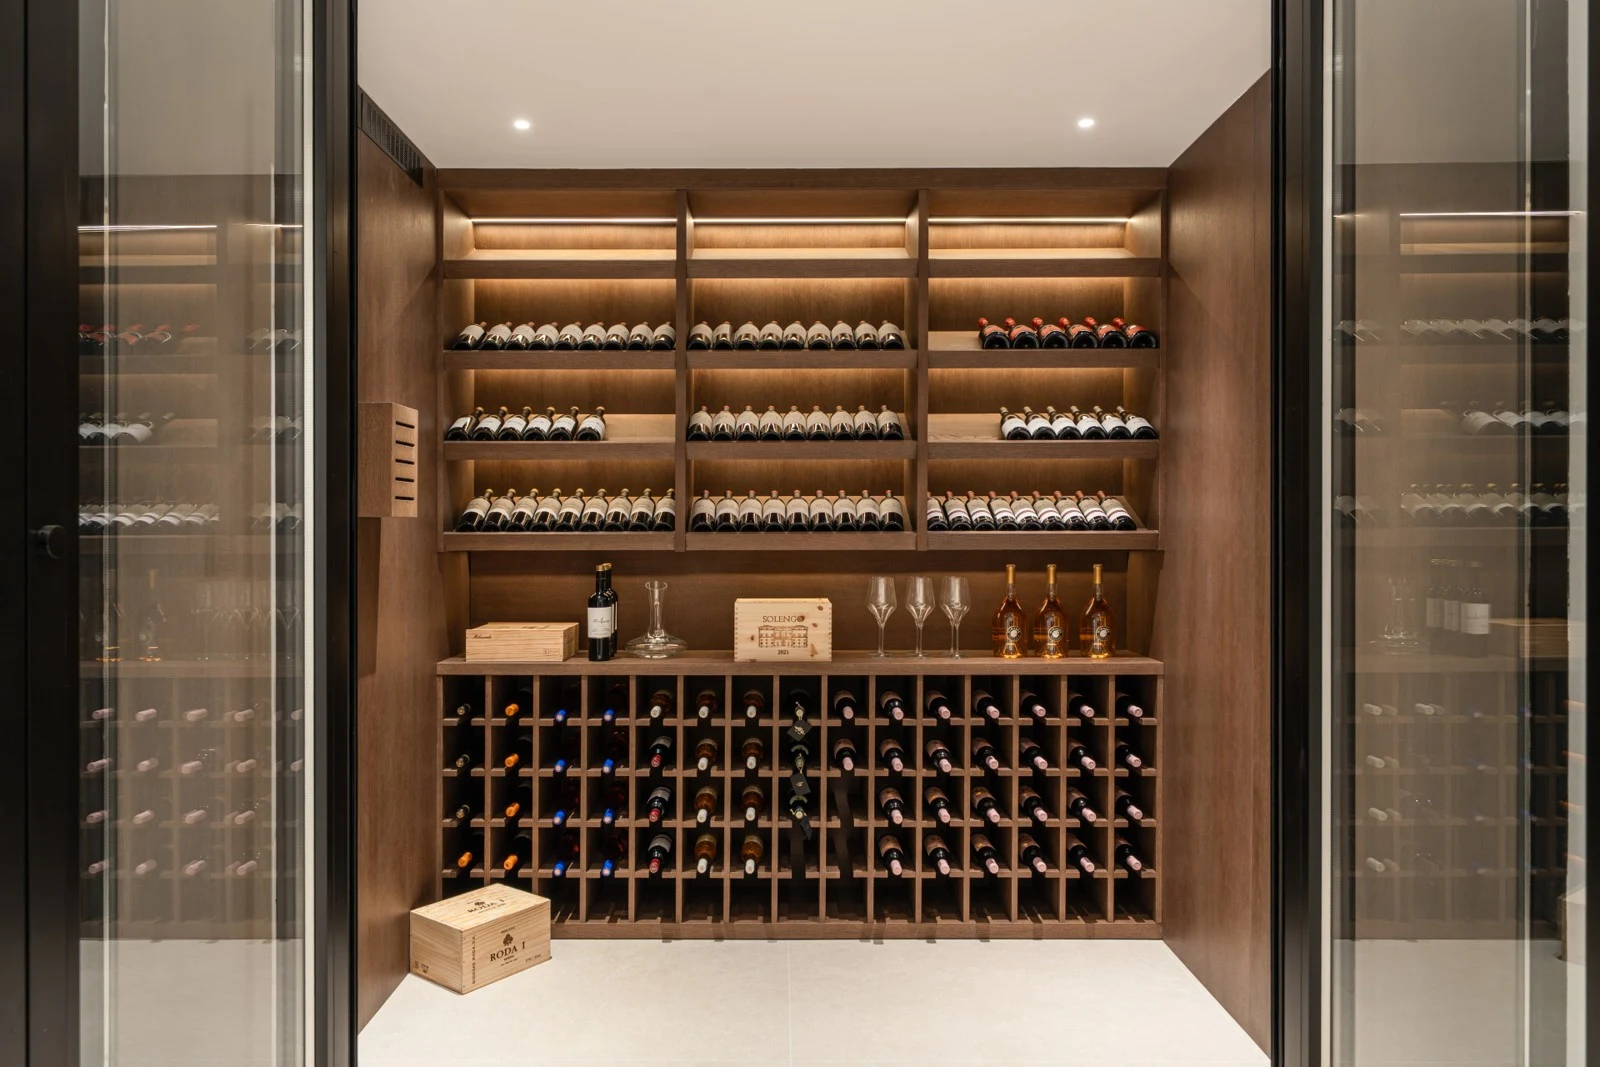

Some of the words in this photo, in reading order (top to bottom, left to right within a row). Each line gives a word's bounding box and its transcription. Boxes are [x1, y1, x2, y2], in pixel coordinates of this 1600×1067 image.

[763, 615, 804, 623] SOLENGO
[490, 945, 517, 962] RODA
[520, 941, 525, 949] I
